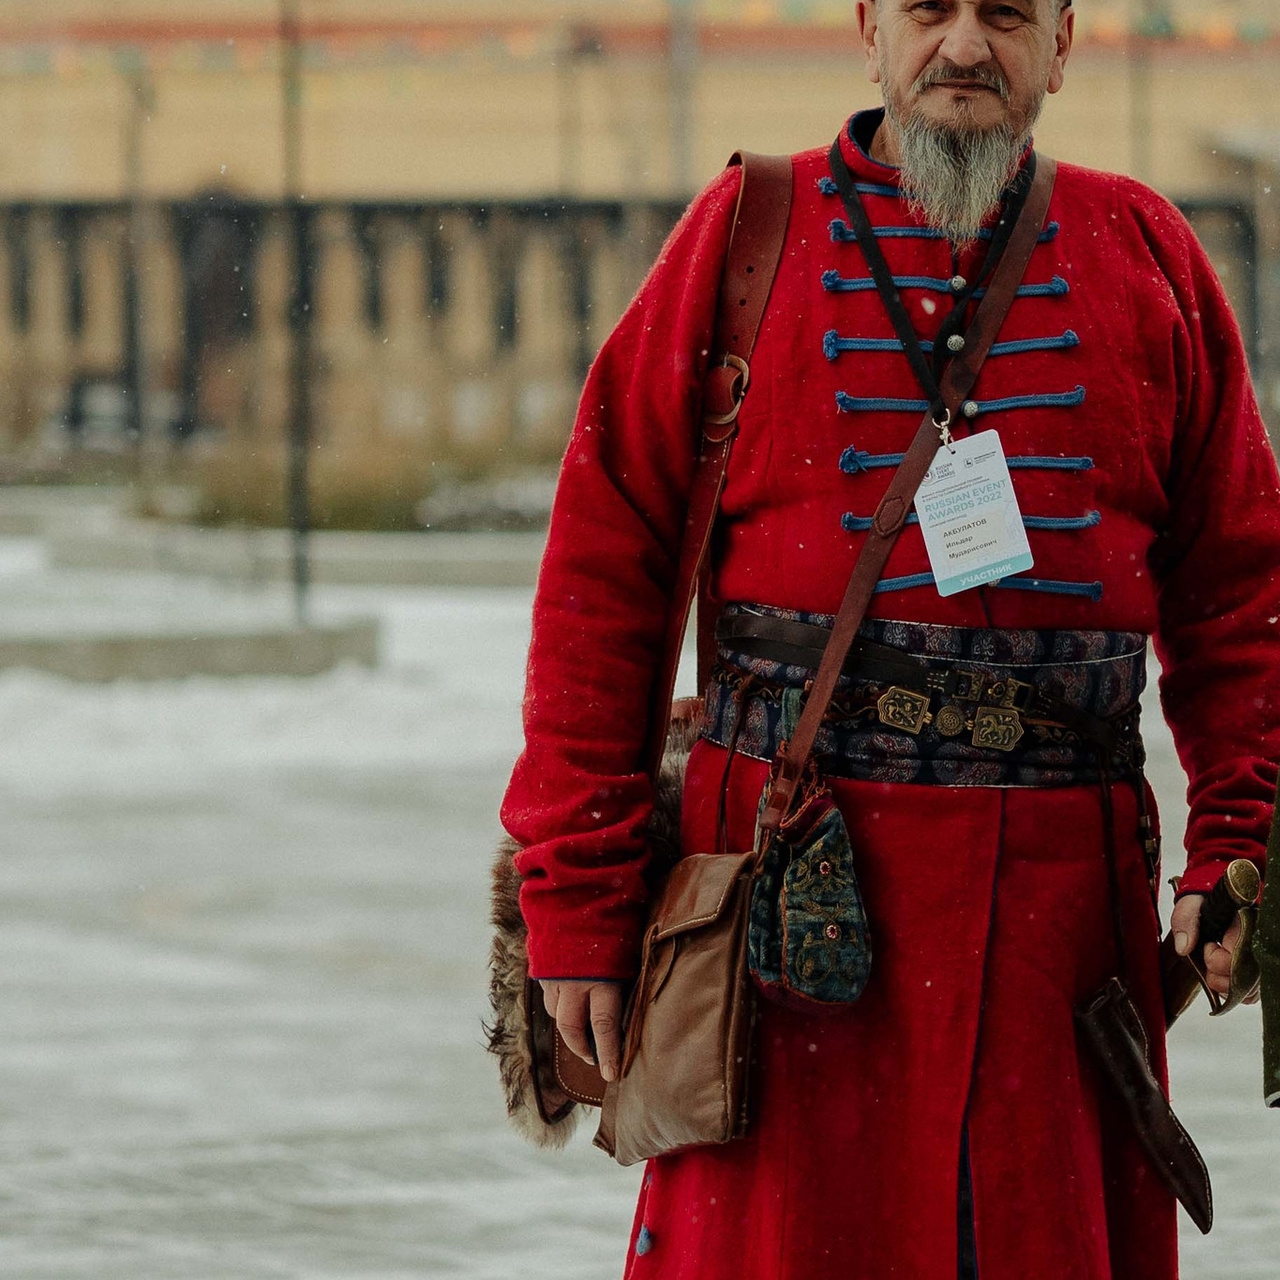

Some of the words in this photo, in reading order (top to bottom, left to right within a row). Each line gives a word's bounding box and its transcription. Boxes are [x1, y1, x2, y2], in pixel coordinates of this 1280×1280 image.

[924, 491, 970, 513] RUSSIAN
[972, 479, 1007, 497] EVENT
[928, 500, 974, 522] AWARDS
[978, 491, 1003, 506] 2022
[943, 518, 987, 538] АКБУЛАТОВ
[946, 535, 973, 549] Ильдар
[960, 563, 1012, 586] УЧАСТНИК
